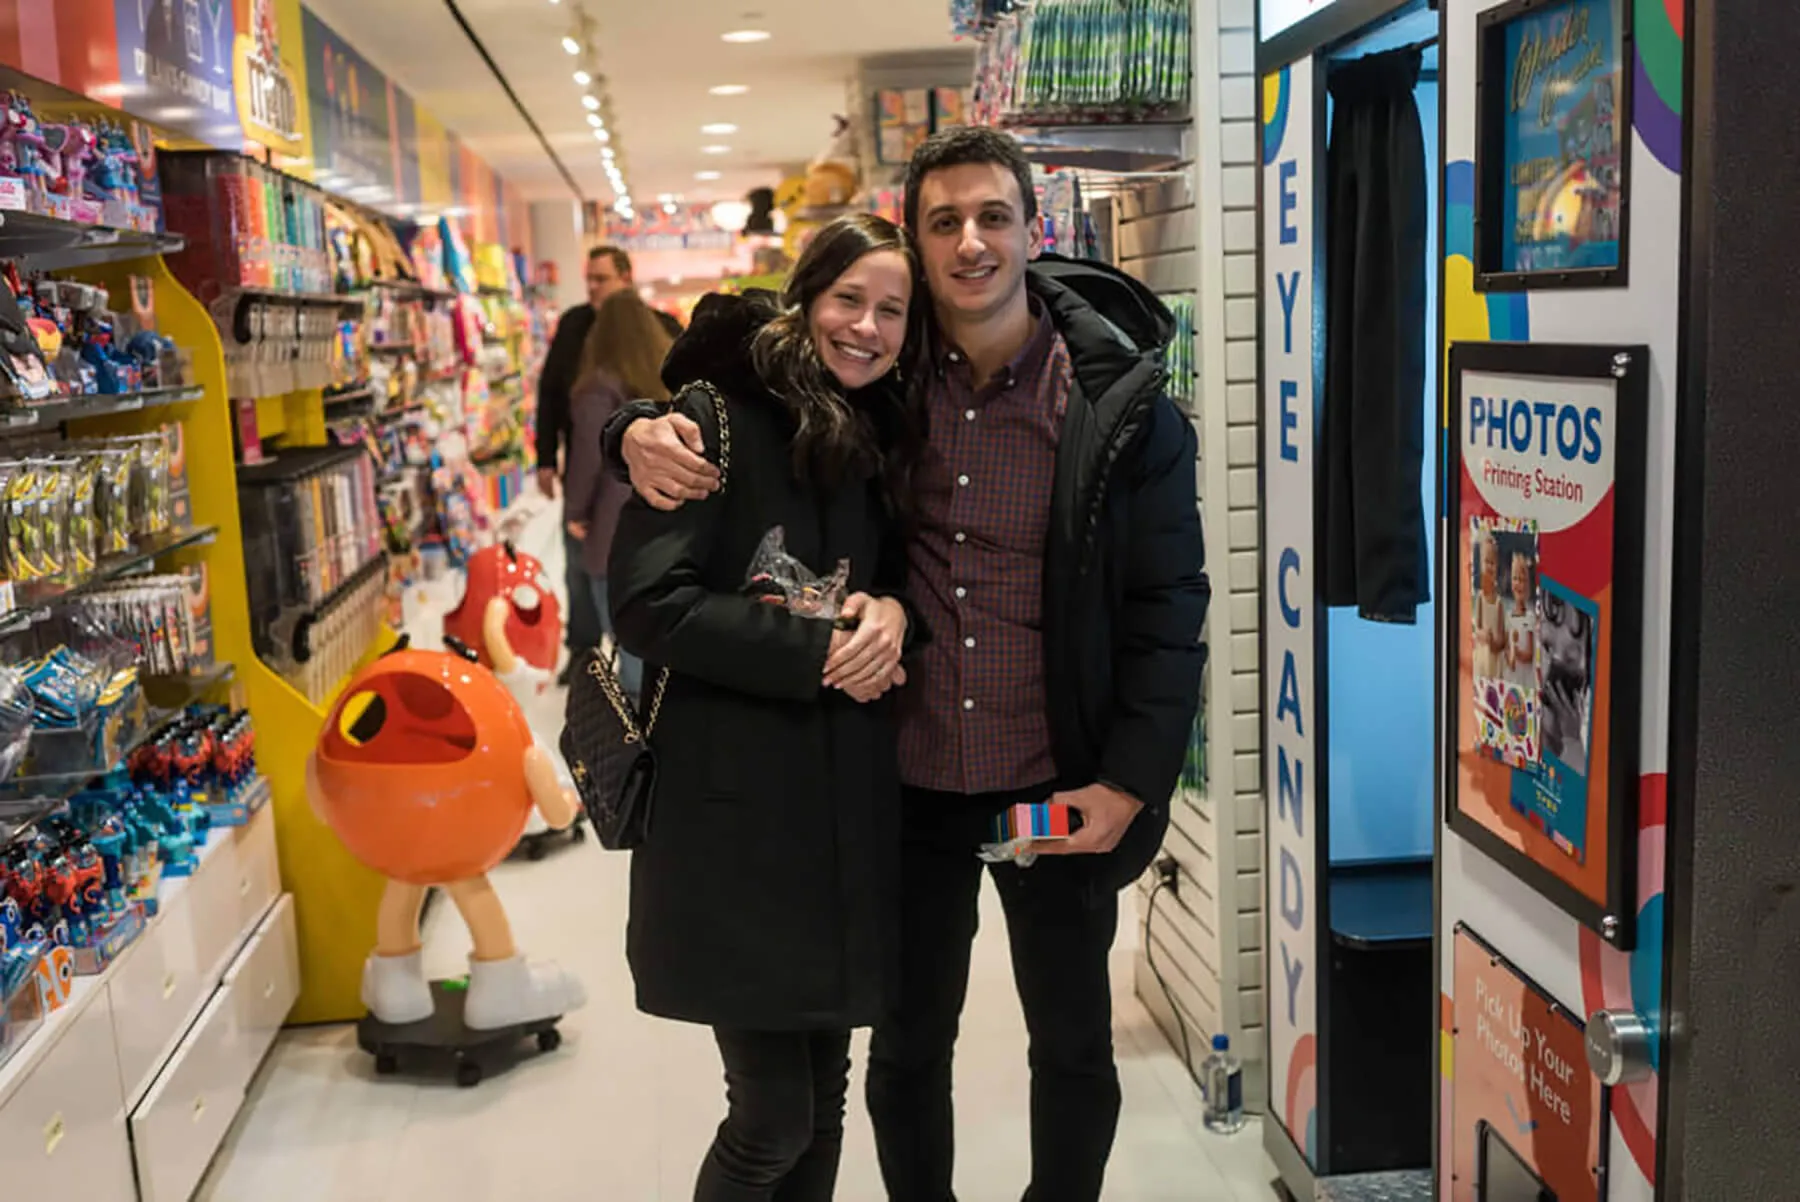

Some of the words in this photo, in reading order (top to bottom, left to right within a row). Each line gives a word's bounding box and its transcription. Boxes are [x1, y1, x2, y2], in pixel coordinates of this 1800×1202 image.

[1276, 159, 1301, 463] EYE
[1469, 396, 1602, 465] PHOTOS
[1484, 459, 1532, 499] Printing
[1535, 468, 1583, 503] Station
[1277, 547, 1304, 1028] CANDY
[1475, 976, 1504, 1017] Pick
[1508, 1004, 1531, 1055] Up
[1534, 1027, 1575, 1087] Your
[1476, 1014, 1526, 1082] Photos
[1530, 1063, 1571, 1125] Here
